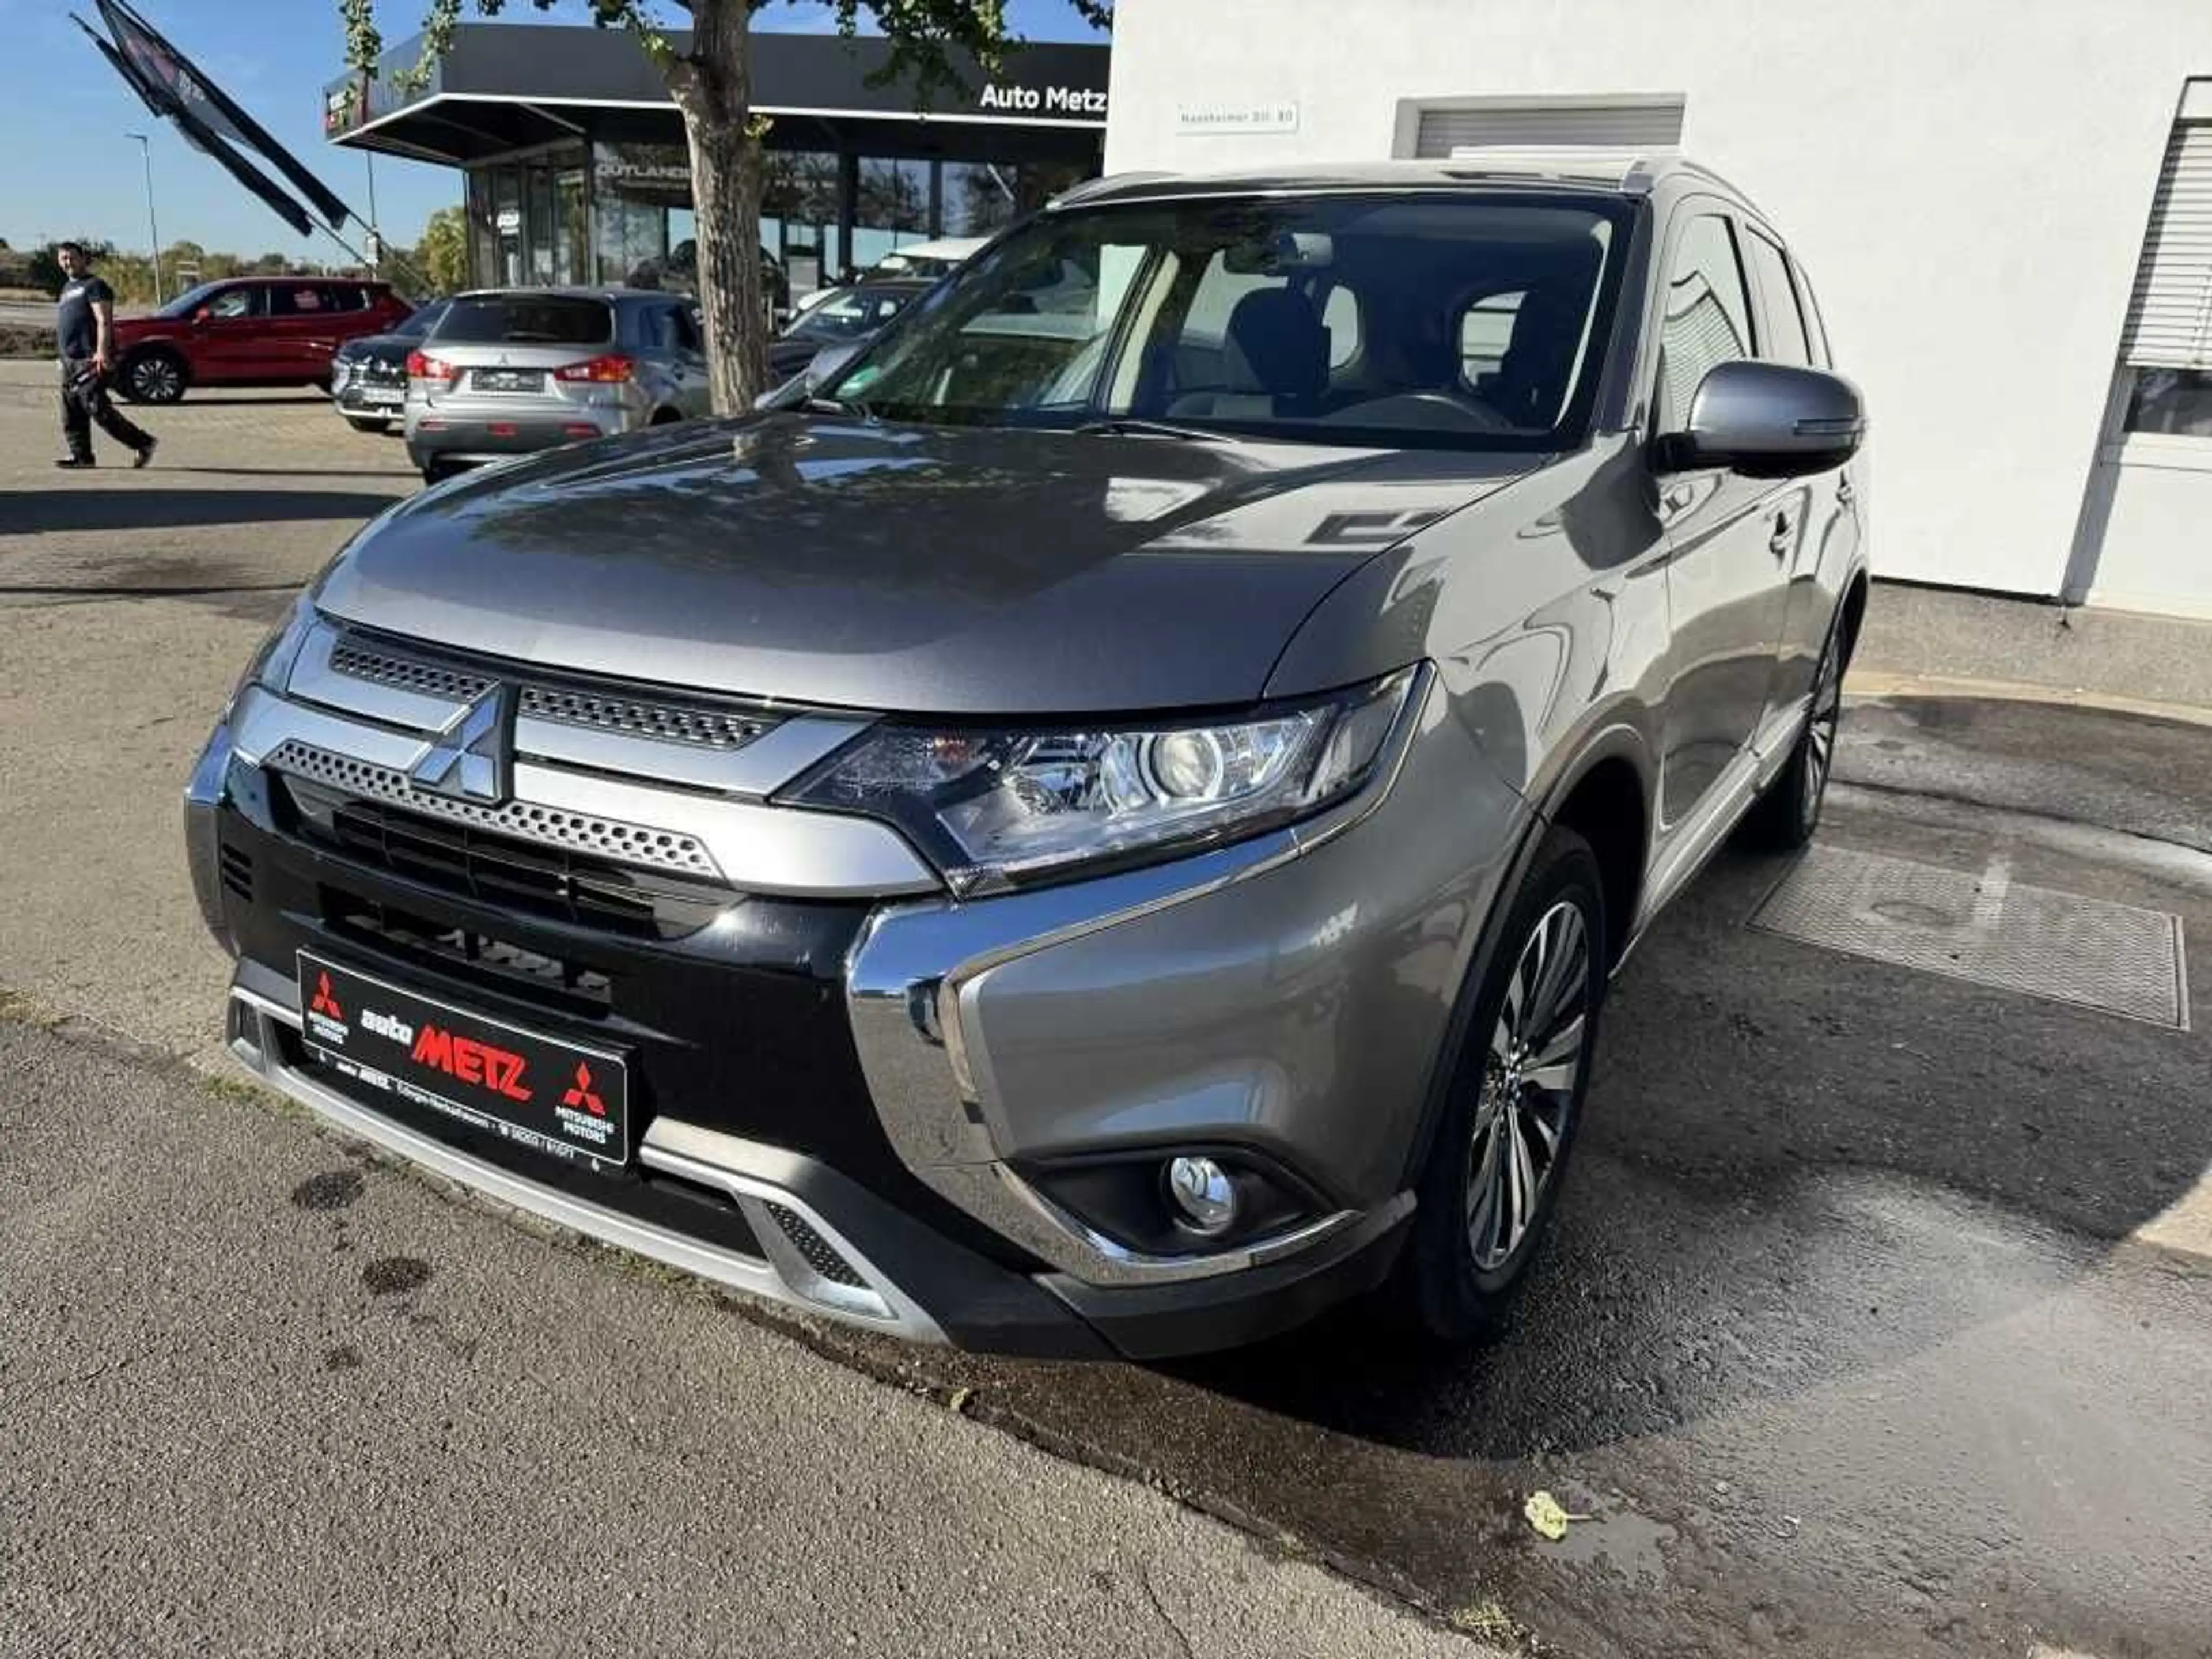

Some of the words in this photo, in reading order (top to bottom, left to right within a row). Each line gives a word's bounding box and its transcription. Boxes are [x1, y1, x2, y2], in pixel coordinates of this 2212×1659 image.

[980, 84, 1039, 109] Auto
[1046, 86, 1107, 111] Metz
[361, 1009, 414, 1046] auto
[411, 1024, 533, 1102] METZ
[554, 1105, 615, 1135] MITSUBISHI
[563, 1120, 606, 1144] MOTORS
